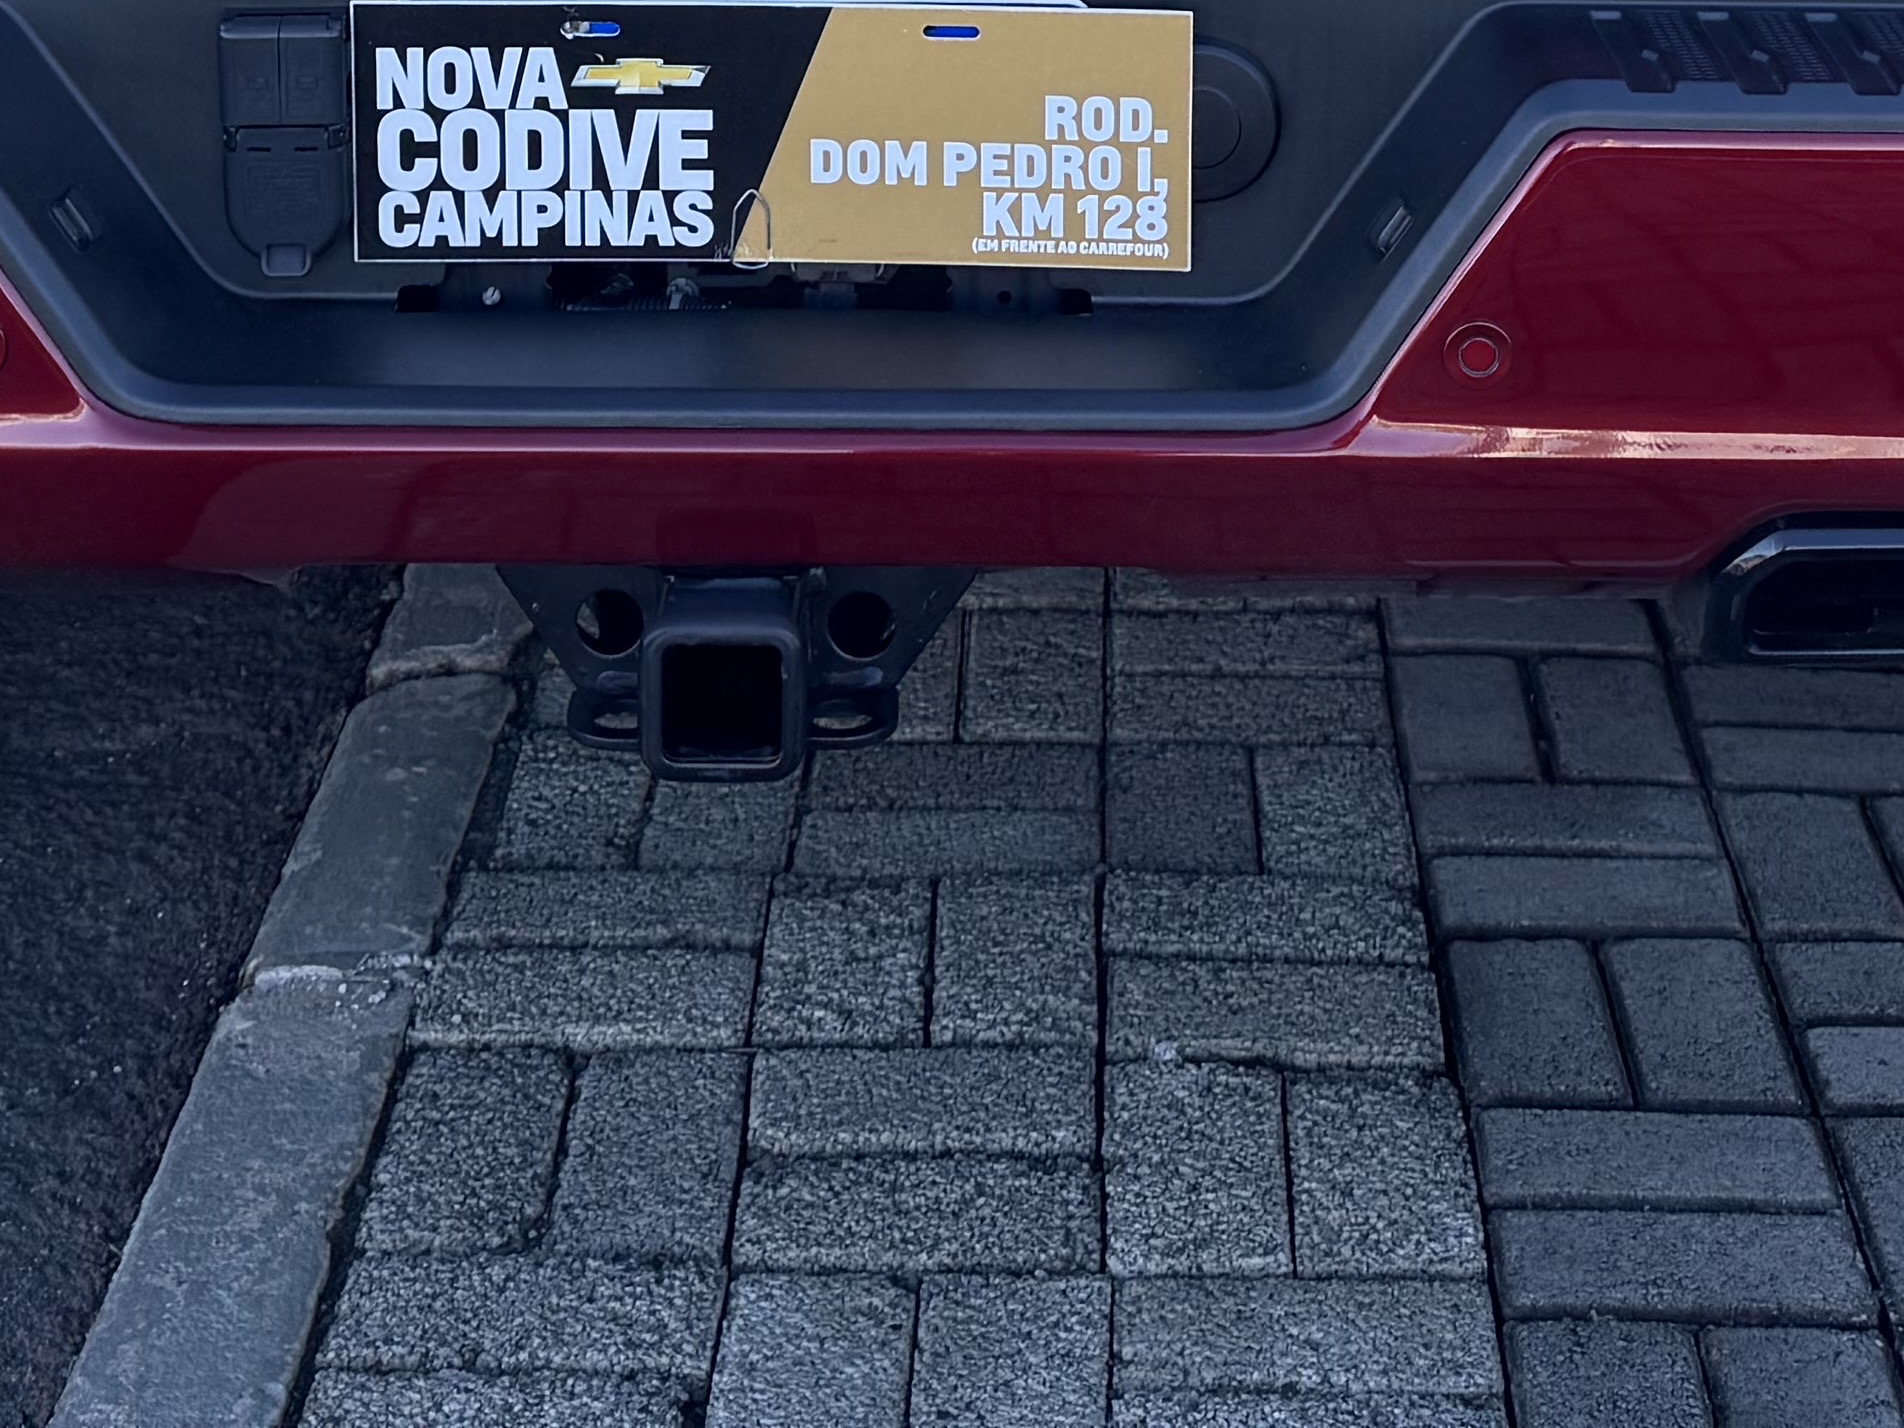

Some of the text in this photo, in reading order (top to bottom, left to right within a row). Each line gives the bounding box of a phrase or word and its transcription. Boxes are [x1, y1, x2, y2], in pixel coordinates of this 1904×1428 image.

[374, 46, 569, 111] NOVA
[1043, 94, 1169, 144] ROD.
[376, 108, 715, 192] CODIVE
[809, 138, 928, 186] DOM
[942, 141, 1122, 192] PEDRO
[377, 189, 715, 248] CAMPINAS
[982, 190, 1169, 241] KM 128
[971, 238, 1170, 260] (EM FRENTE AO CARREFOUR)
